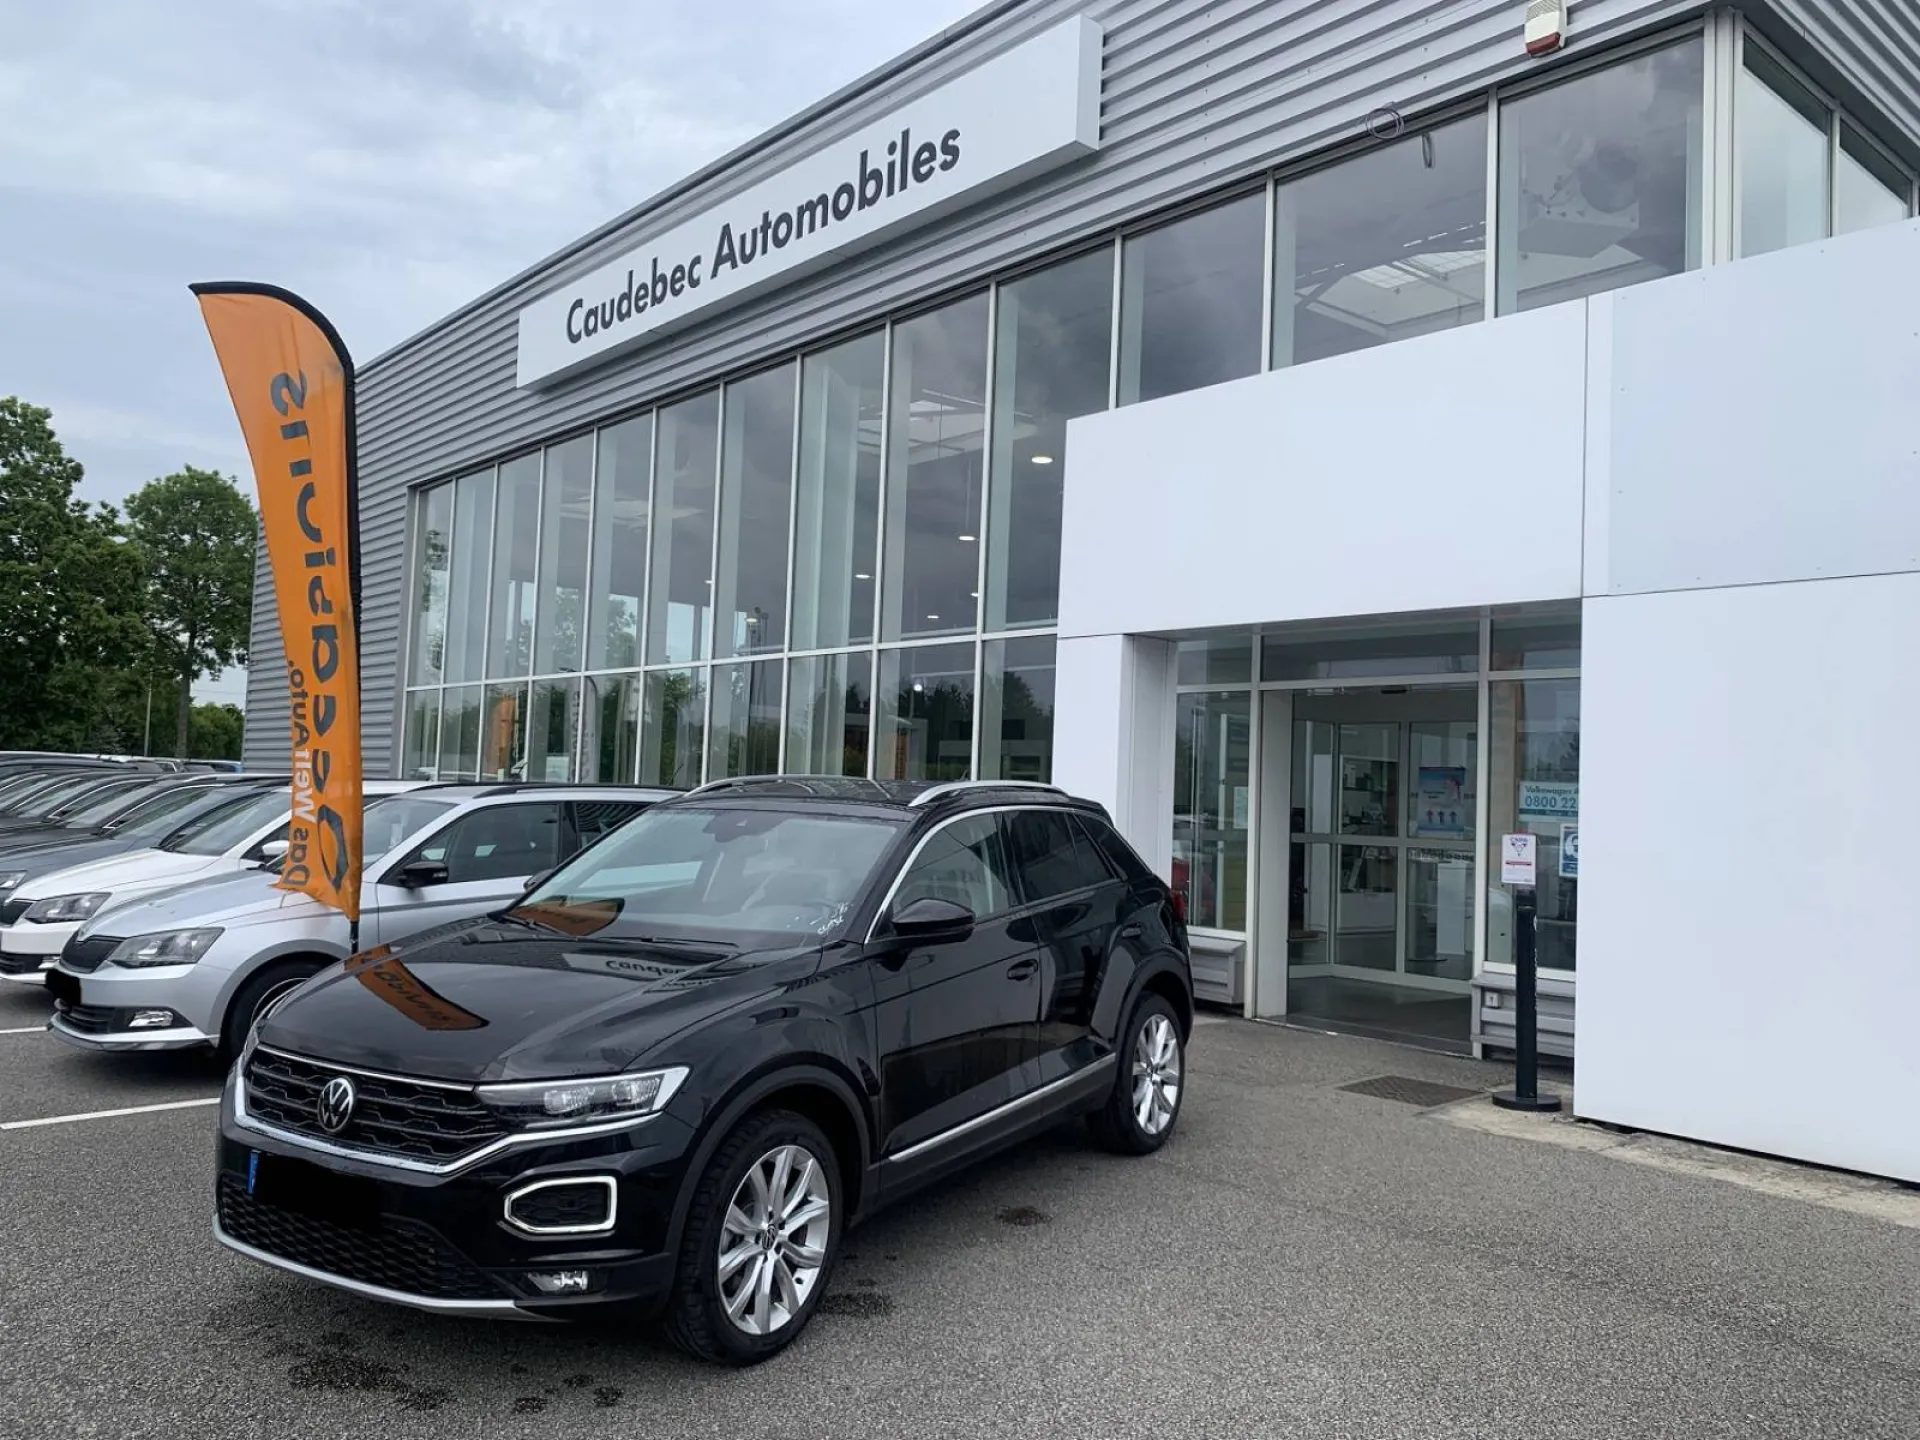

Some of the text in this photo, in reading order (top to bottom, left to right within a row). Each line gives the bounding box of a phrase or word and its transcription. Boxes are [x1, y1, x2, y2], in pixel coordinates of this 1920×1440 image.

[566, 127, 961, 344] Caudebec Automobiles
[1525, 796, 1557, 808] 0800
